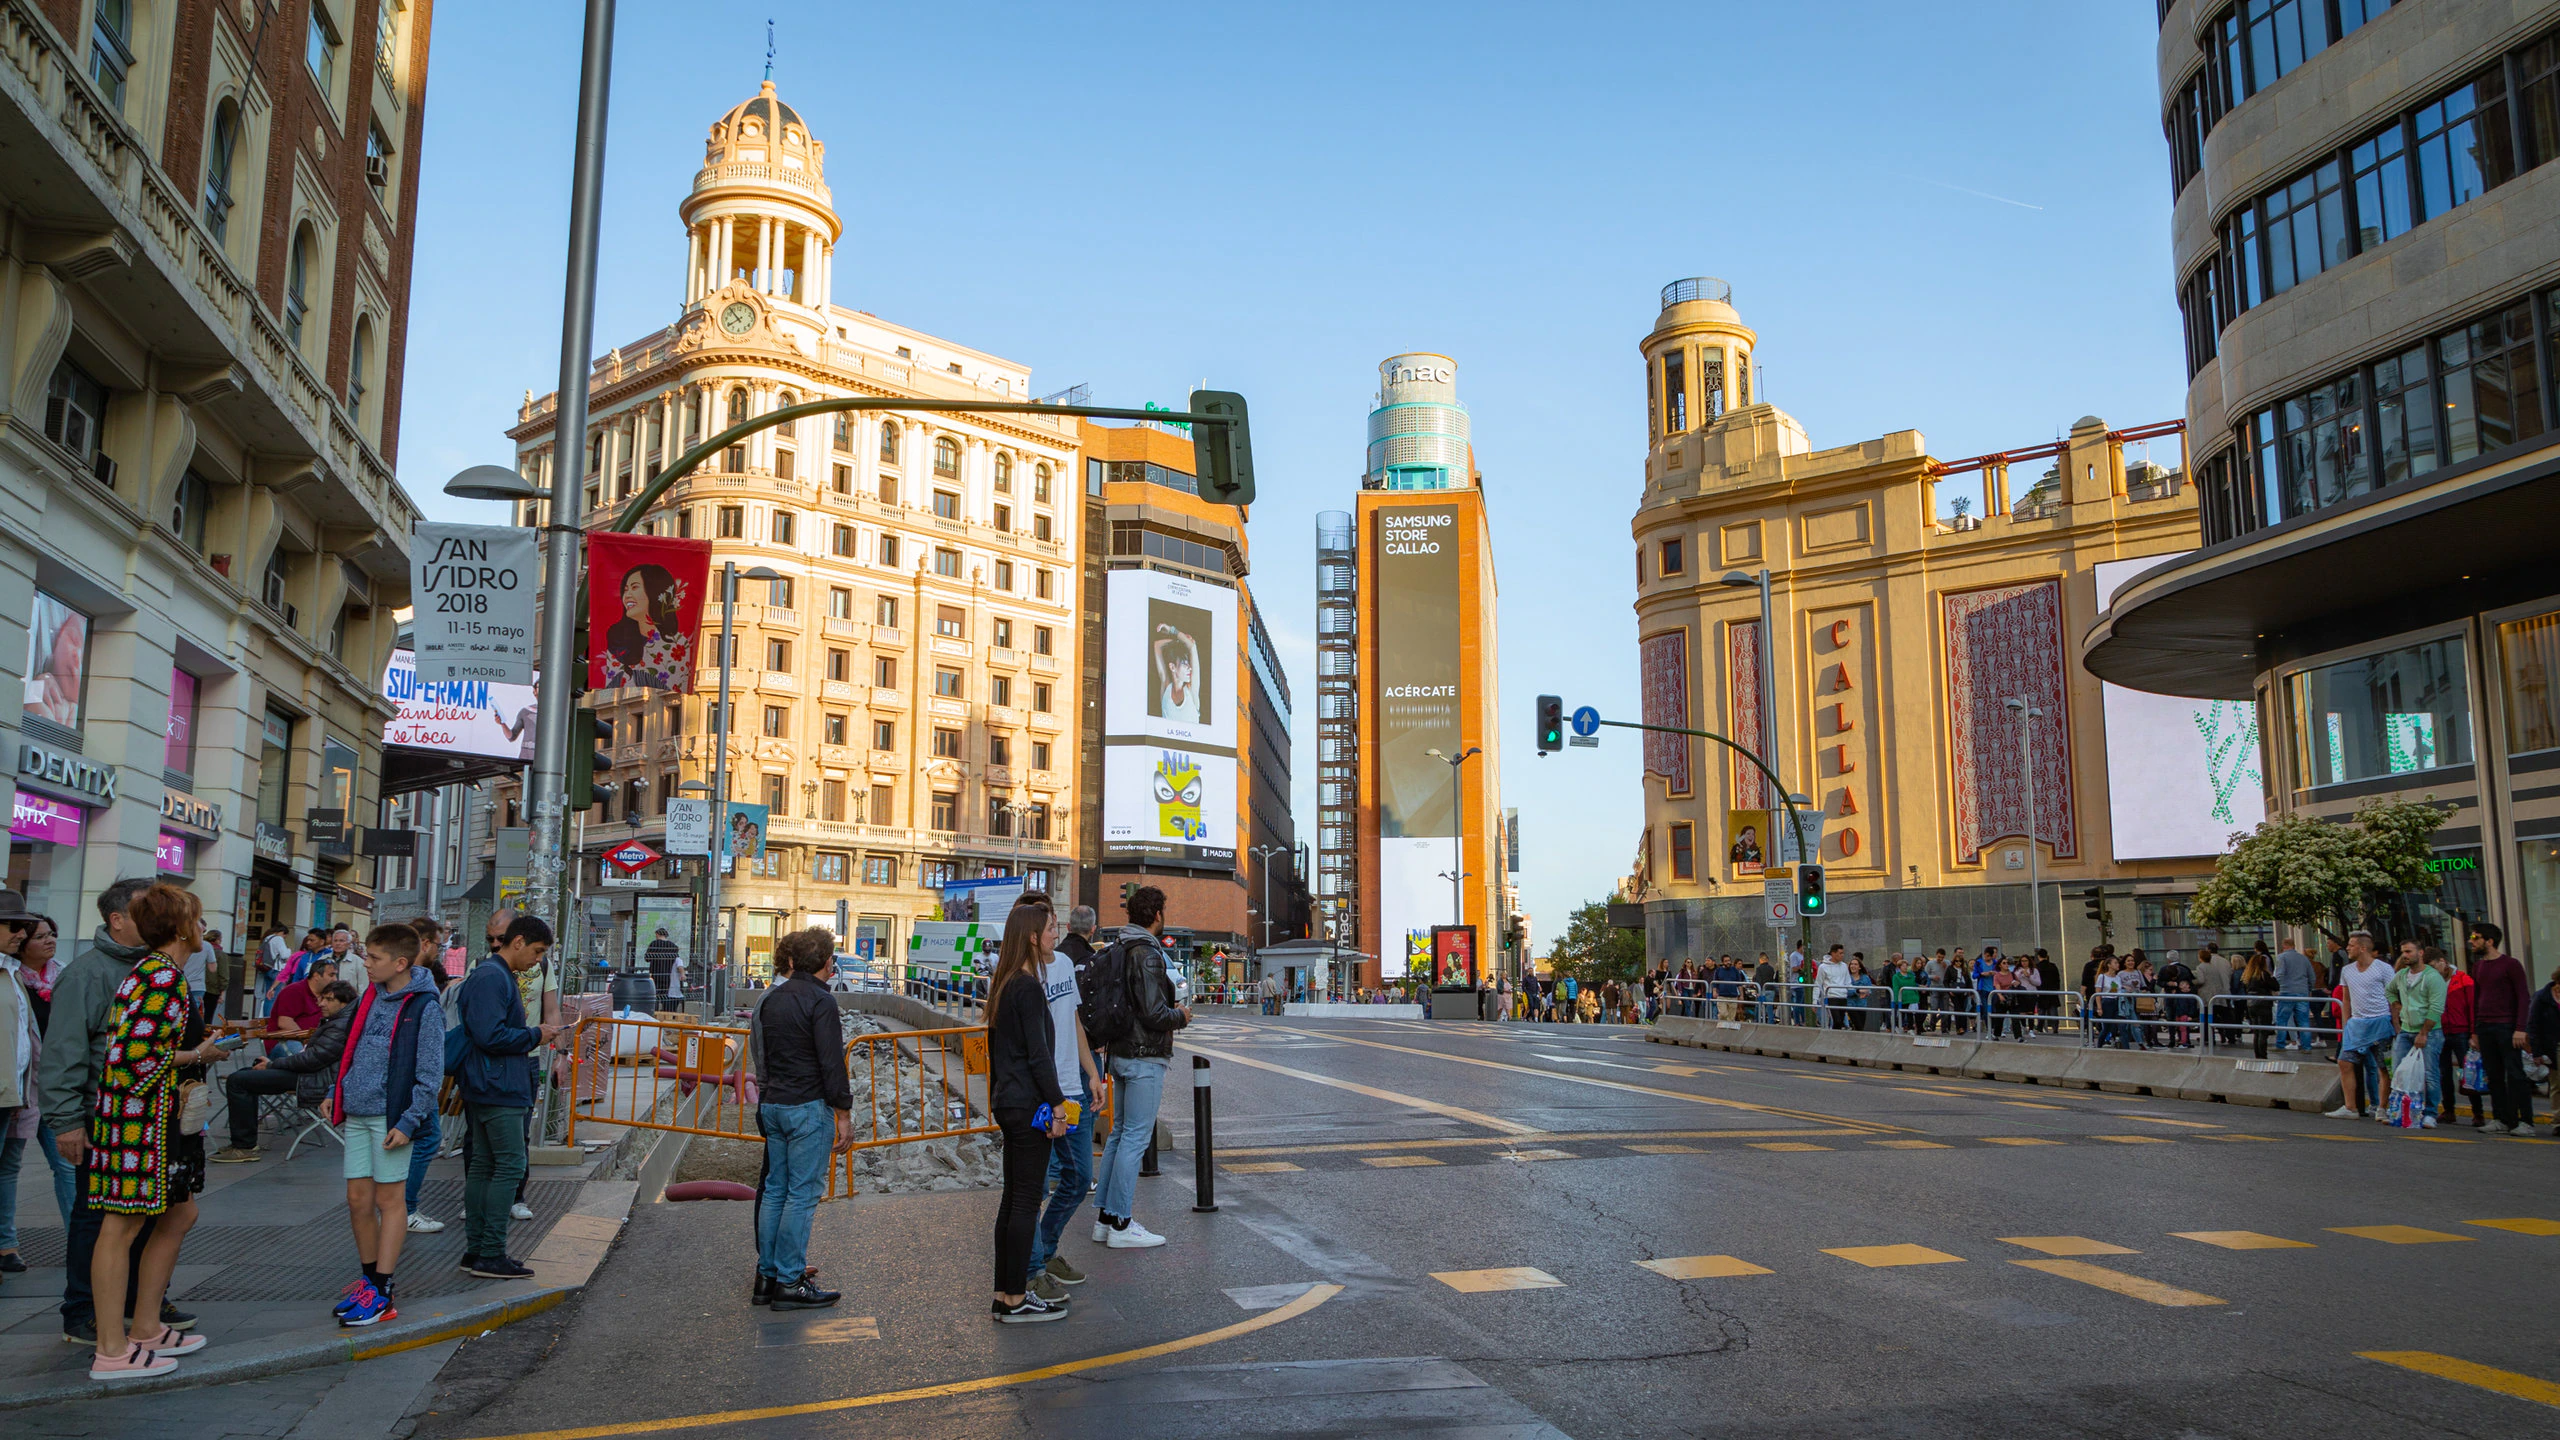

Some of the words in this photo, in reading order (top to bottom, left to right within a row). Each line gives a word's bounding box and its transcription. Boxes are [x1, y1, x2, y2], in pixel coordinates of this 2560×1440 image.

[1388, 362, 1451, 386] fnac
[1385, 515, 1452, 528] SAMSUNG
[1385, 529, 1428, 541] STORE
[428, 537, 488, 565] SAN
[1385, 542, 1440, 555] CALLAO
[422, 565, 518, 592] ISIDRO
[436, 593, 488, 613] 2018
[447, 621, 482, 635] 11-15
[487, 625, 525, 639] mayo
[462, 667, 506, 677] MADRID
[1385, 683, 1456, 698] ACÉRCATE
[1175, 730, 1192, 738] SHICA
[1831, 618, 1859, 857] CALLAO
[26, 745, 117, 799] DENTIX
[160, 792, 223, 833] DENTIX
[672, 803, 693, 813] SAN
[670, 813, 702, 822] ISIDRO
[619, 852, 645, 860] Metro
[1209, 849, 1233, 858] MADRID
[1337, 912, 1349, 949] fnac
[930, 938, 955, 946] MADRID
